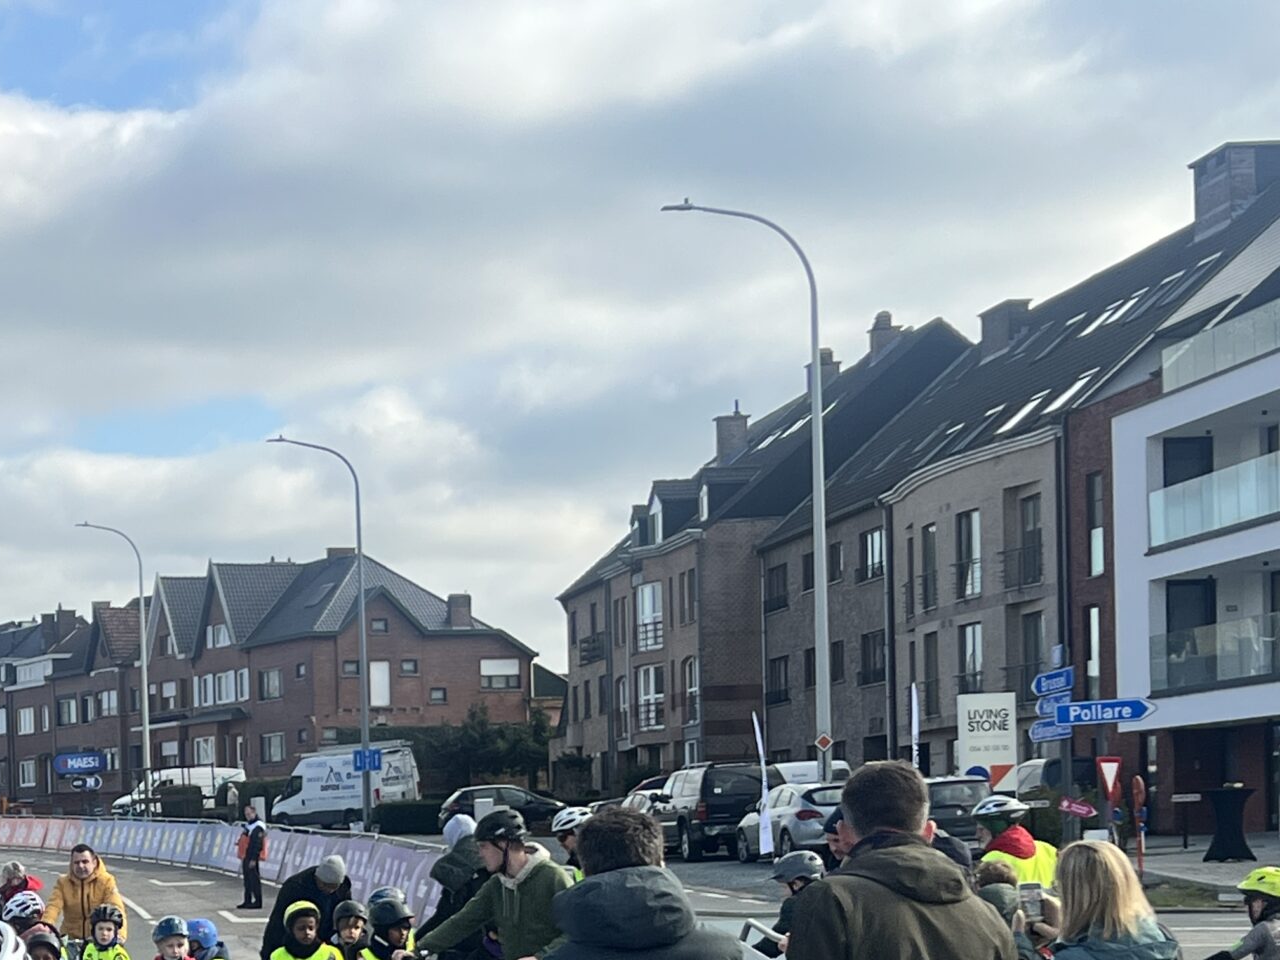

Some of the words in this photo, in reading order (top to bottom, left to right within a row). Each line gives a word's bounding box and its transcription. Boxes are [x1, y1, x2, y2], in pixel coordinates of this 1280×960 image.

[968, 708, 1010, 720] LIVING
[1069, 704, 1133, 722] Pollare
[968, 720, 1010, 732] STONE
